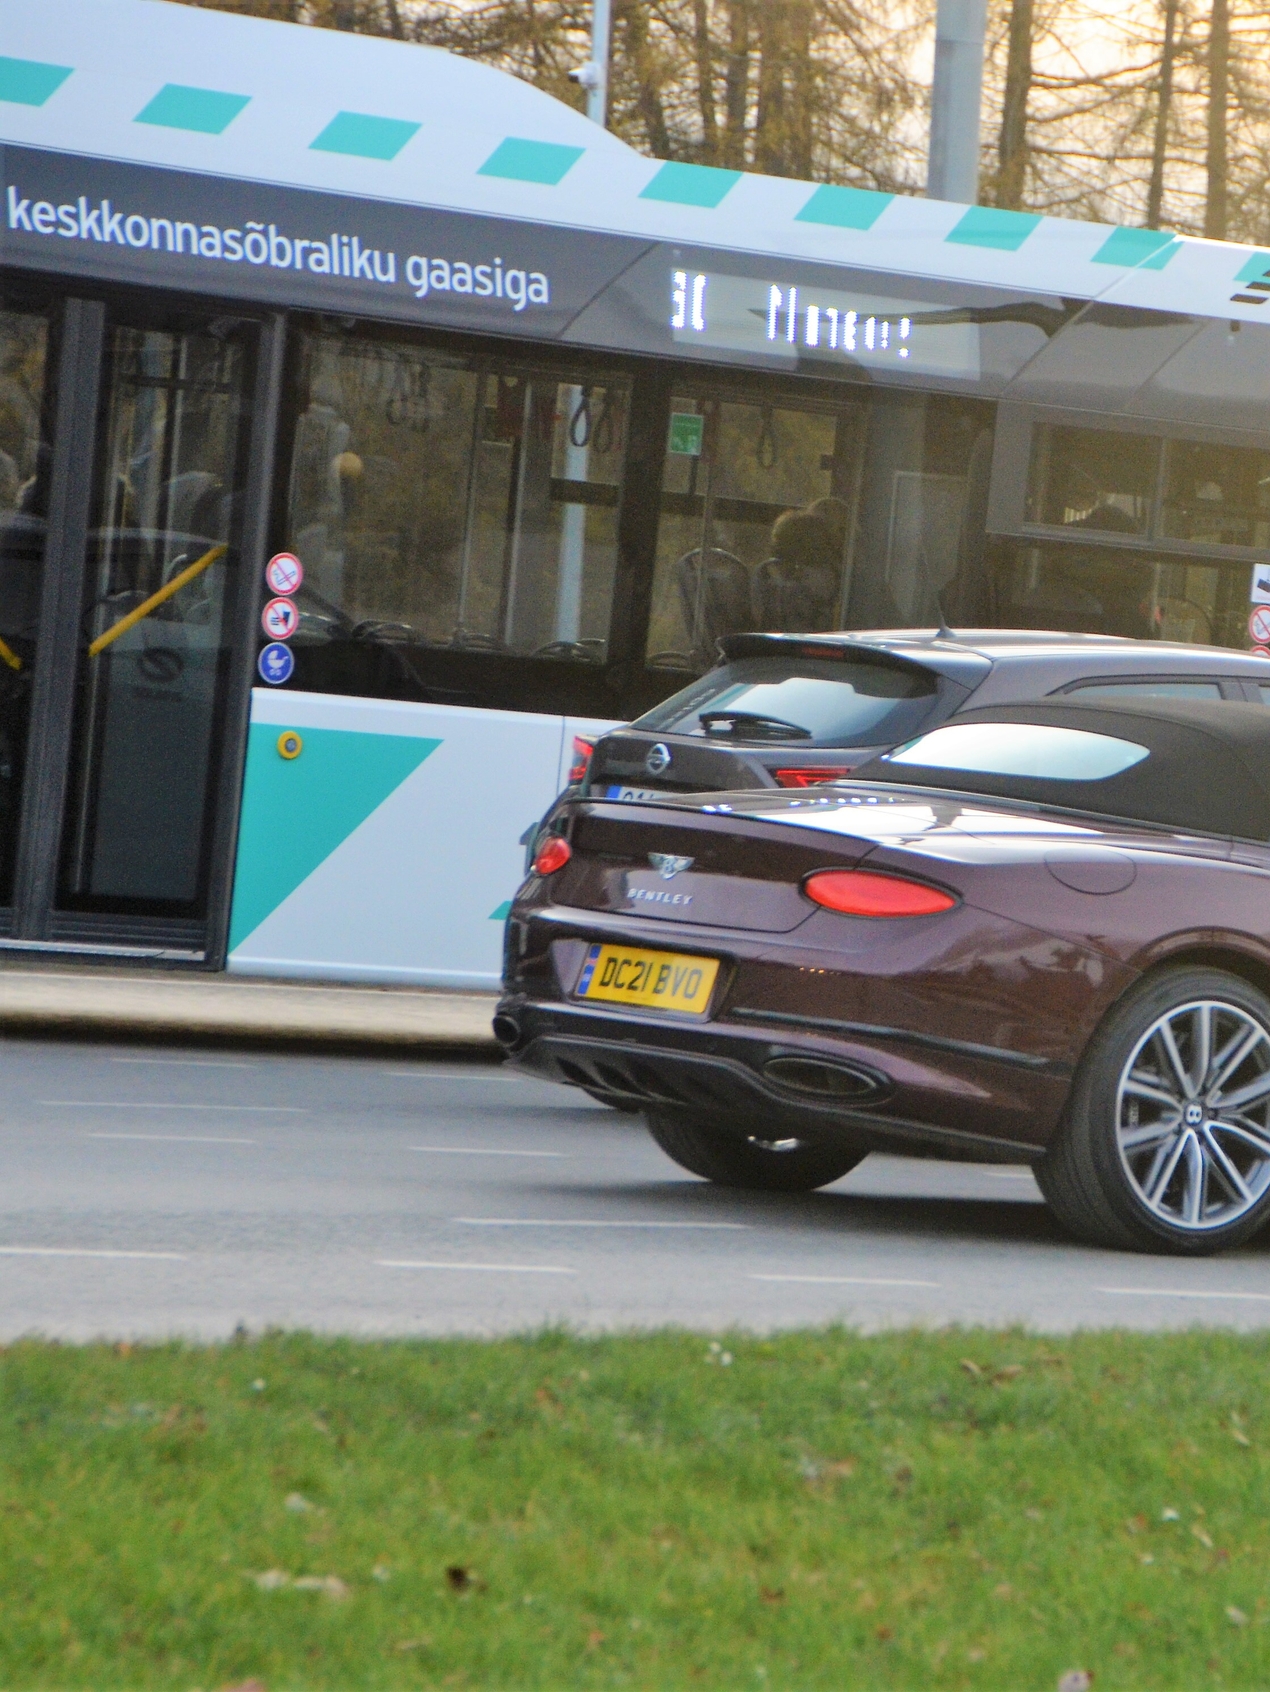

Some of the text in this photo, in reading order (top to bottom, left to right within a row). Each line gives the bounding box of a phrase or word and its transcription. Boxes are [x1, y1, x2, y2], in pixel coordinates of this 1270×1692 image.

[7, 185, 550, 311] keskkonnasõbraliku gaasiga
[627, 887, 693, 905] BENTLEY
[599, 957, 702, 999] DC21 BVO
